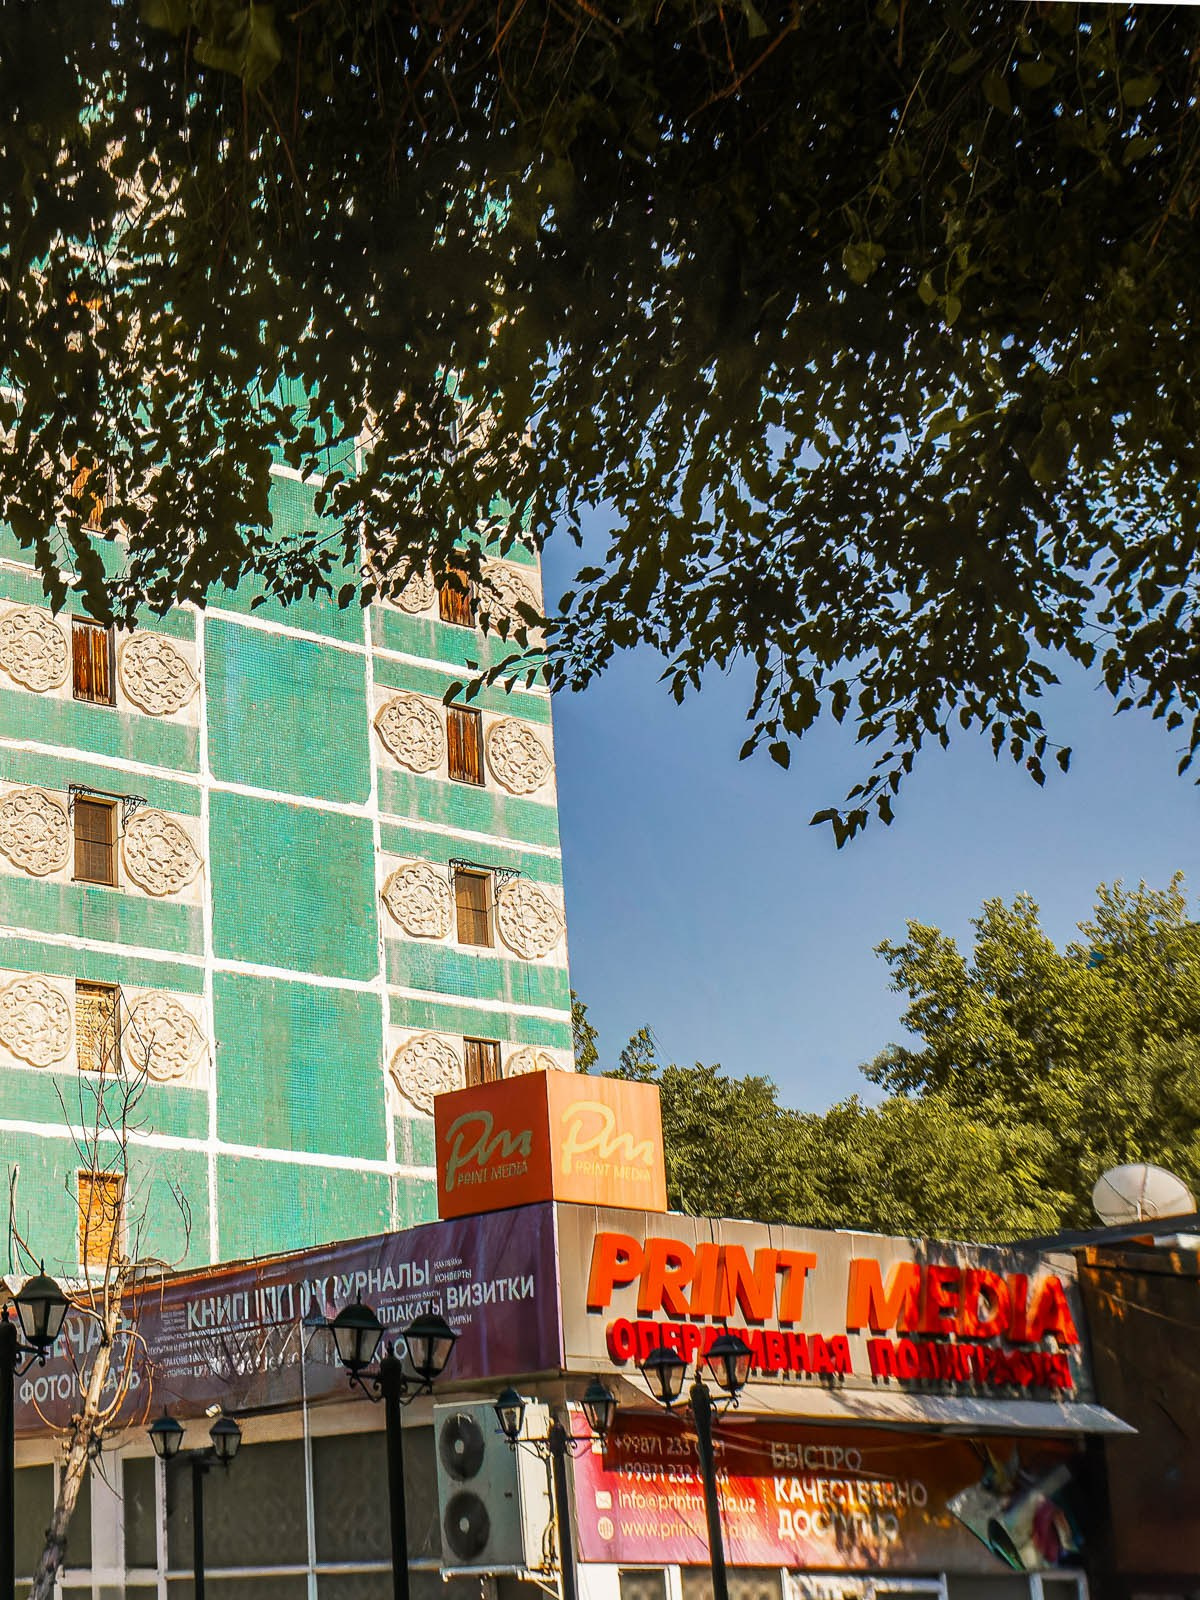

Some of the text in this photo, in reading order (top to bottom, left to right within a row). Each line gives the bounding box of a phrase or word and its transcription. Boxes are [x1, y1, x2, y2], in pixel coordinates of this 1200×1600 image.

[457, 1159, 529, 1185] PRINT MEDIA
[575, 1160, 652, 1182] PRINT MEDIA
[446, 1274, 535, 1310] ВИЗИТКИ
[586, 1232, 1080, 1345] PRINT MEDIA
[377, 1298, 443, 1324] ПЛАКАТЫ
[771, 1441, 863, 1471] БЫСТРО
[618, 1489, 757, 1514] info@printmdia.uz
[773, 1476, 928, 1508] КАЧЕСТВЕННО
